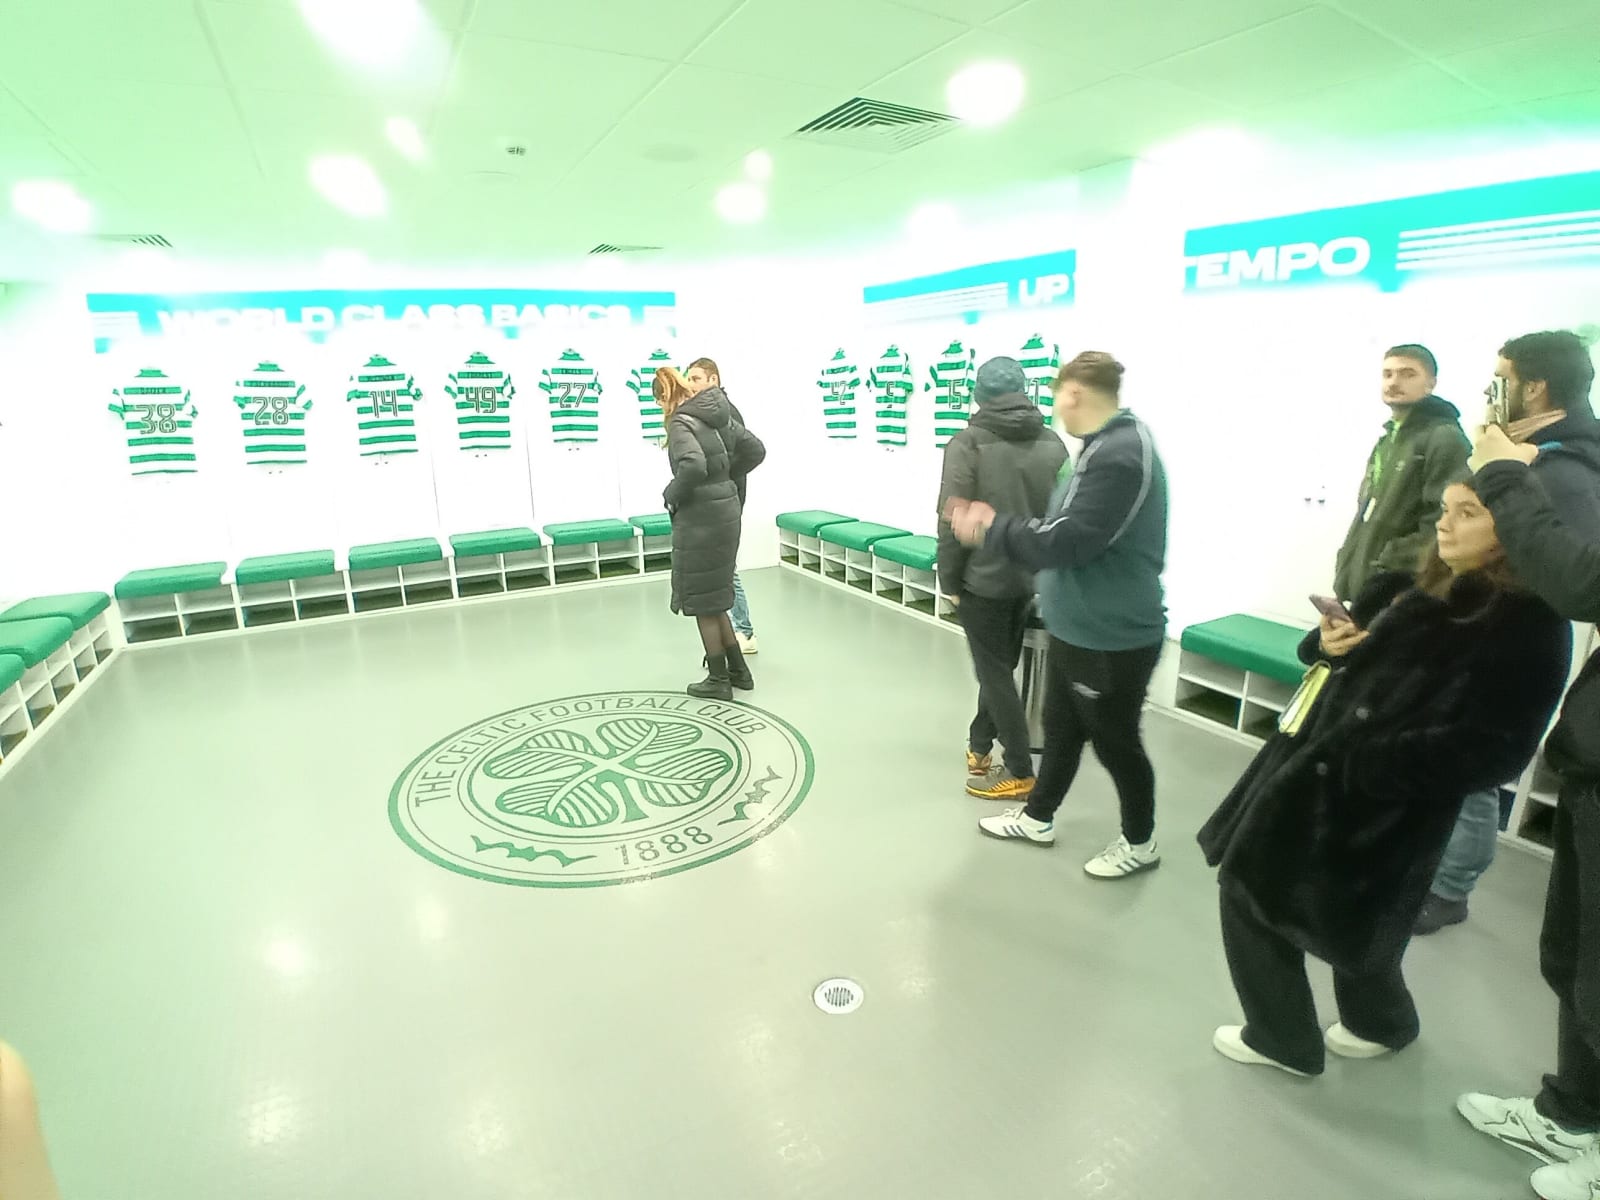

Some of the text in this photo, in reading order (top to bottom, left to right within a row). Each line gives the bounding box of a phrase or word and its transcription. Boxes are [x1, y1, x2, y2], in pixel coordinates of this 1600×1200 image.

[1019, 272, 1070, 305] UP
[157, 304, 630, 335] WORLD CLASS BASICS
[370, 390, 398, 418] 14
[465, 386, 497, 413] 49
[558, 382, 587, 408] 27
[948, 379, 962, 410] 15
[135, 403, 177, 434] 38
[254, 396, 289, 425] 28
[415, 697, 768, 808] THE CELTIC FOOTBALL CLUB
[614, 826, 713, 866] 1888
